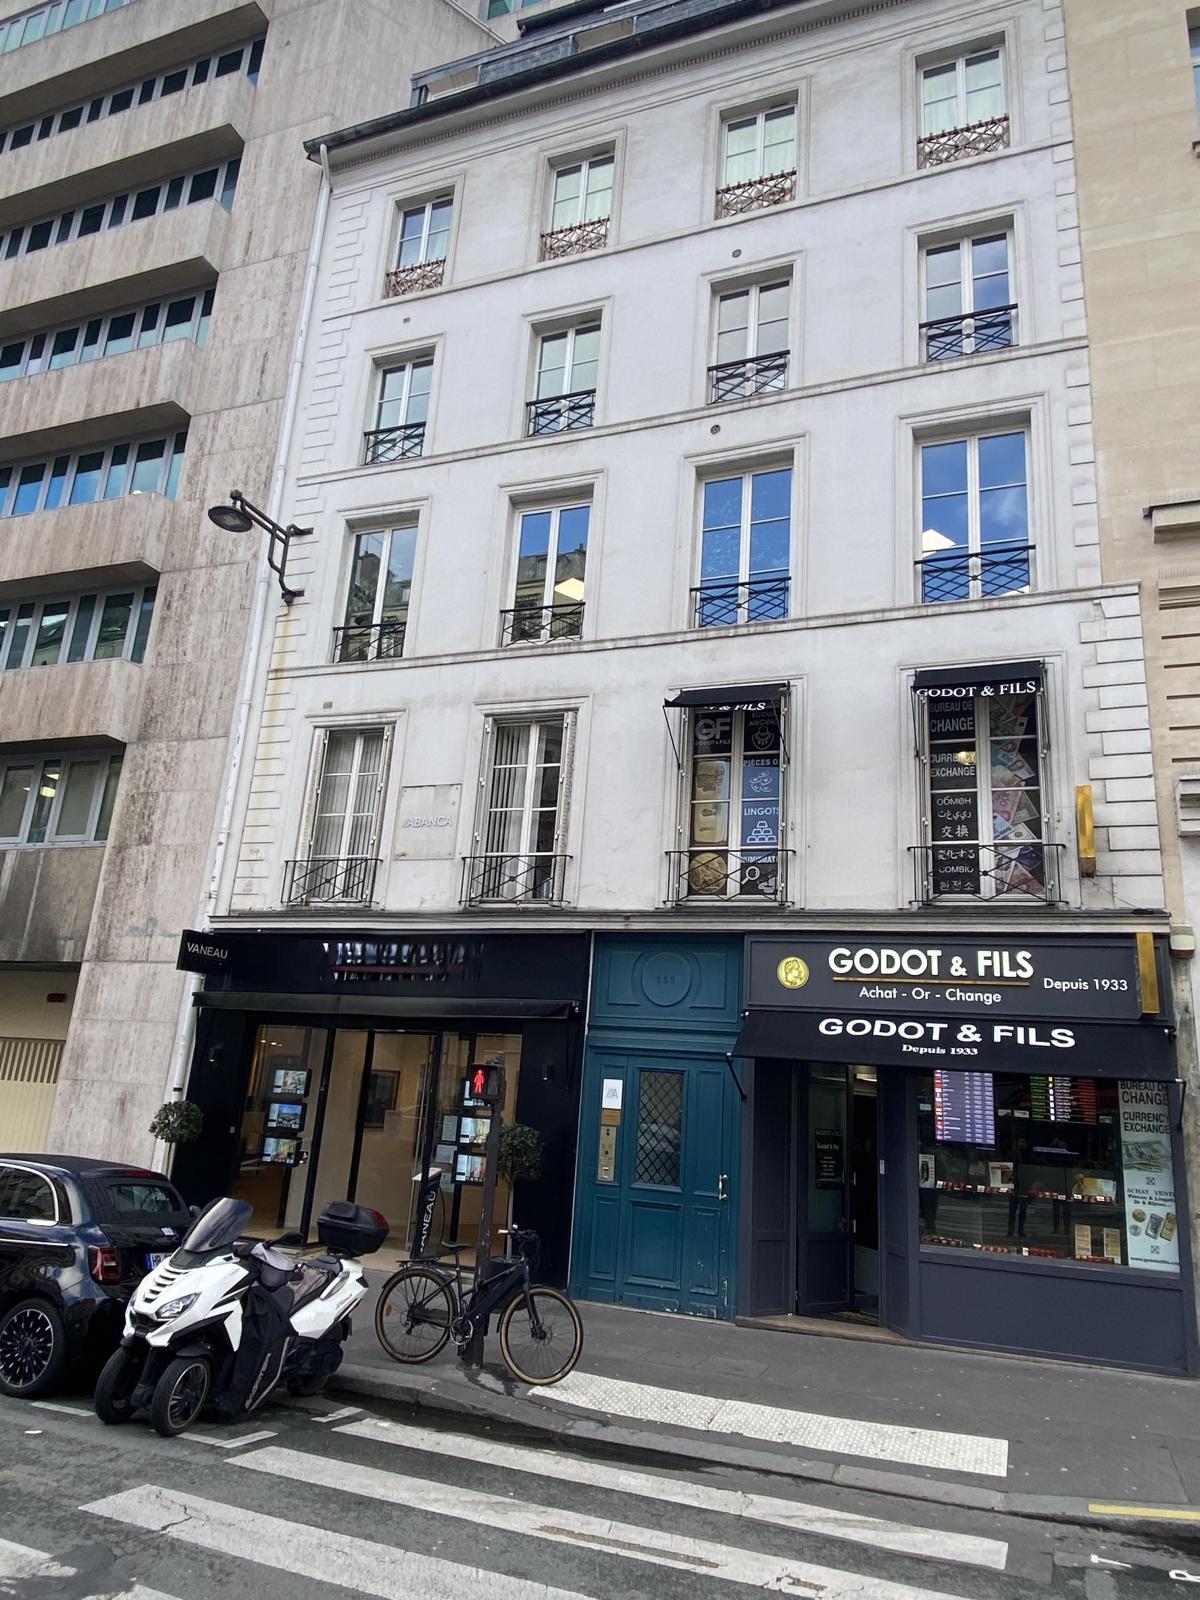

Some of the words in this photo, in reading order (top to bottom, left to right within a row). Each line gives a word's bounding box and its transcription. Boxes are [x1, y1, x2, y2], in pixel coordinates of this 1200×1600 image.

[916, 687, 977, 697] GODOT
[981, 685, 995, 697] &
[999, 681, 1036, 695] FILS
[929, 701, 961, 712] BUREAU
[962, 700, 973, 711] DE
[930, 717, 974, 732] CHANGE
[930, 766, 976, 777] EXCHANGE
[187, 942, 229, 959] VANEAU
[828, 947, 942, 976] GODOT
[950, 956, 968, 976] &
[977, 950, 1034, 978] FILS
[1043, 977, 1089, 992] Depuis
[1093, 978, 1128, 991] 1933
[859, 986, 898, 999] Achat
[912, 987, 931, 1000] Or
[945, 988, 1002, 1005] Change
[818, 1018, 948, 1041] GODOT
[956, 1024, 983, 1042] &
[993, 1025, 1076, 1048] FILS
[902, 1044, 947, 1055] Depuis
[950, 1047, 979, 1056] 1933
[1120, 1081, 1155, 1091] BUREAU
[1123, 1122, 1171, 1134] EXCHANGE
